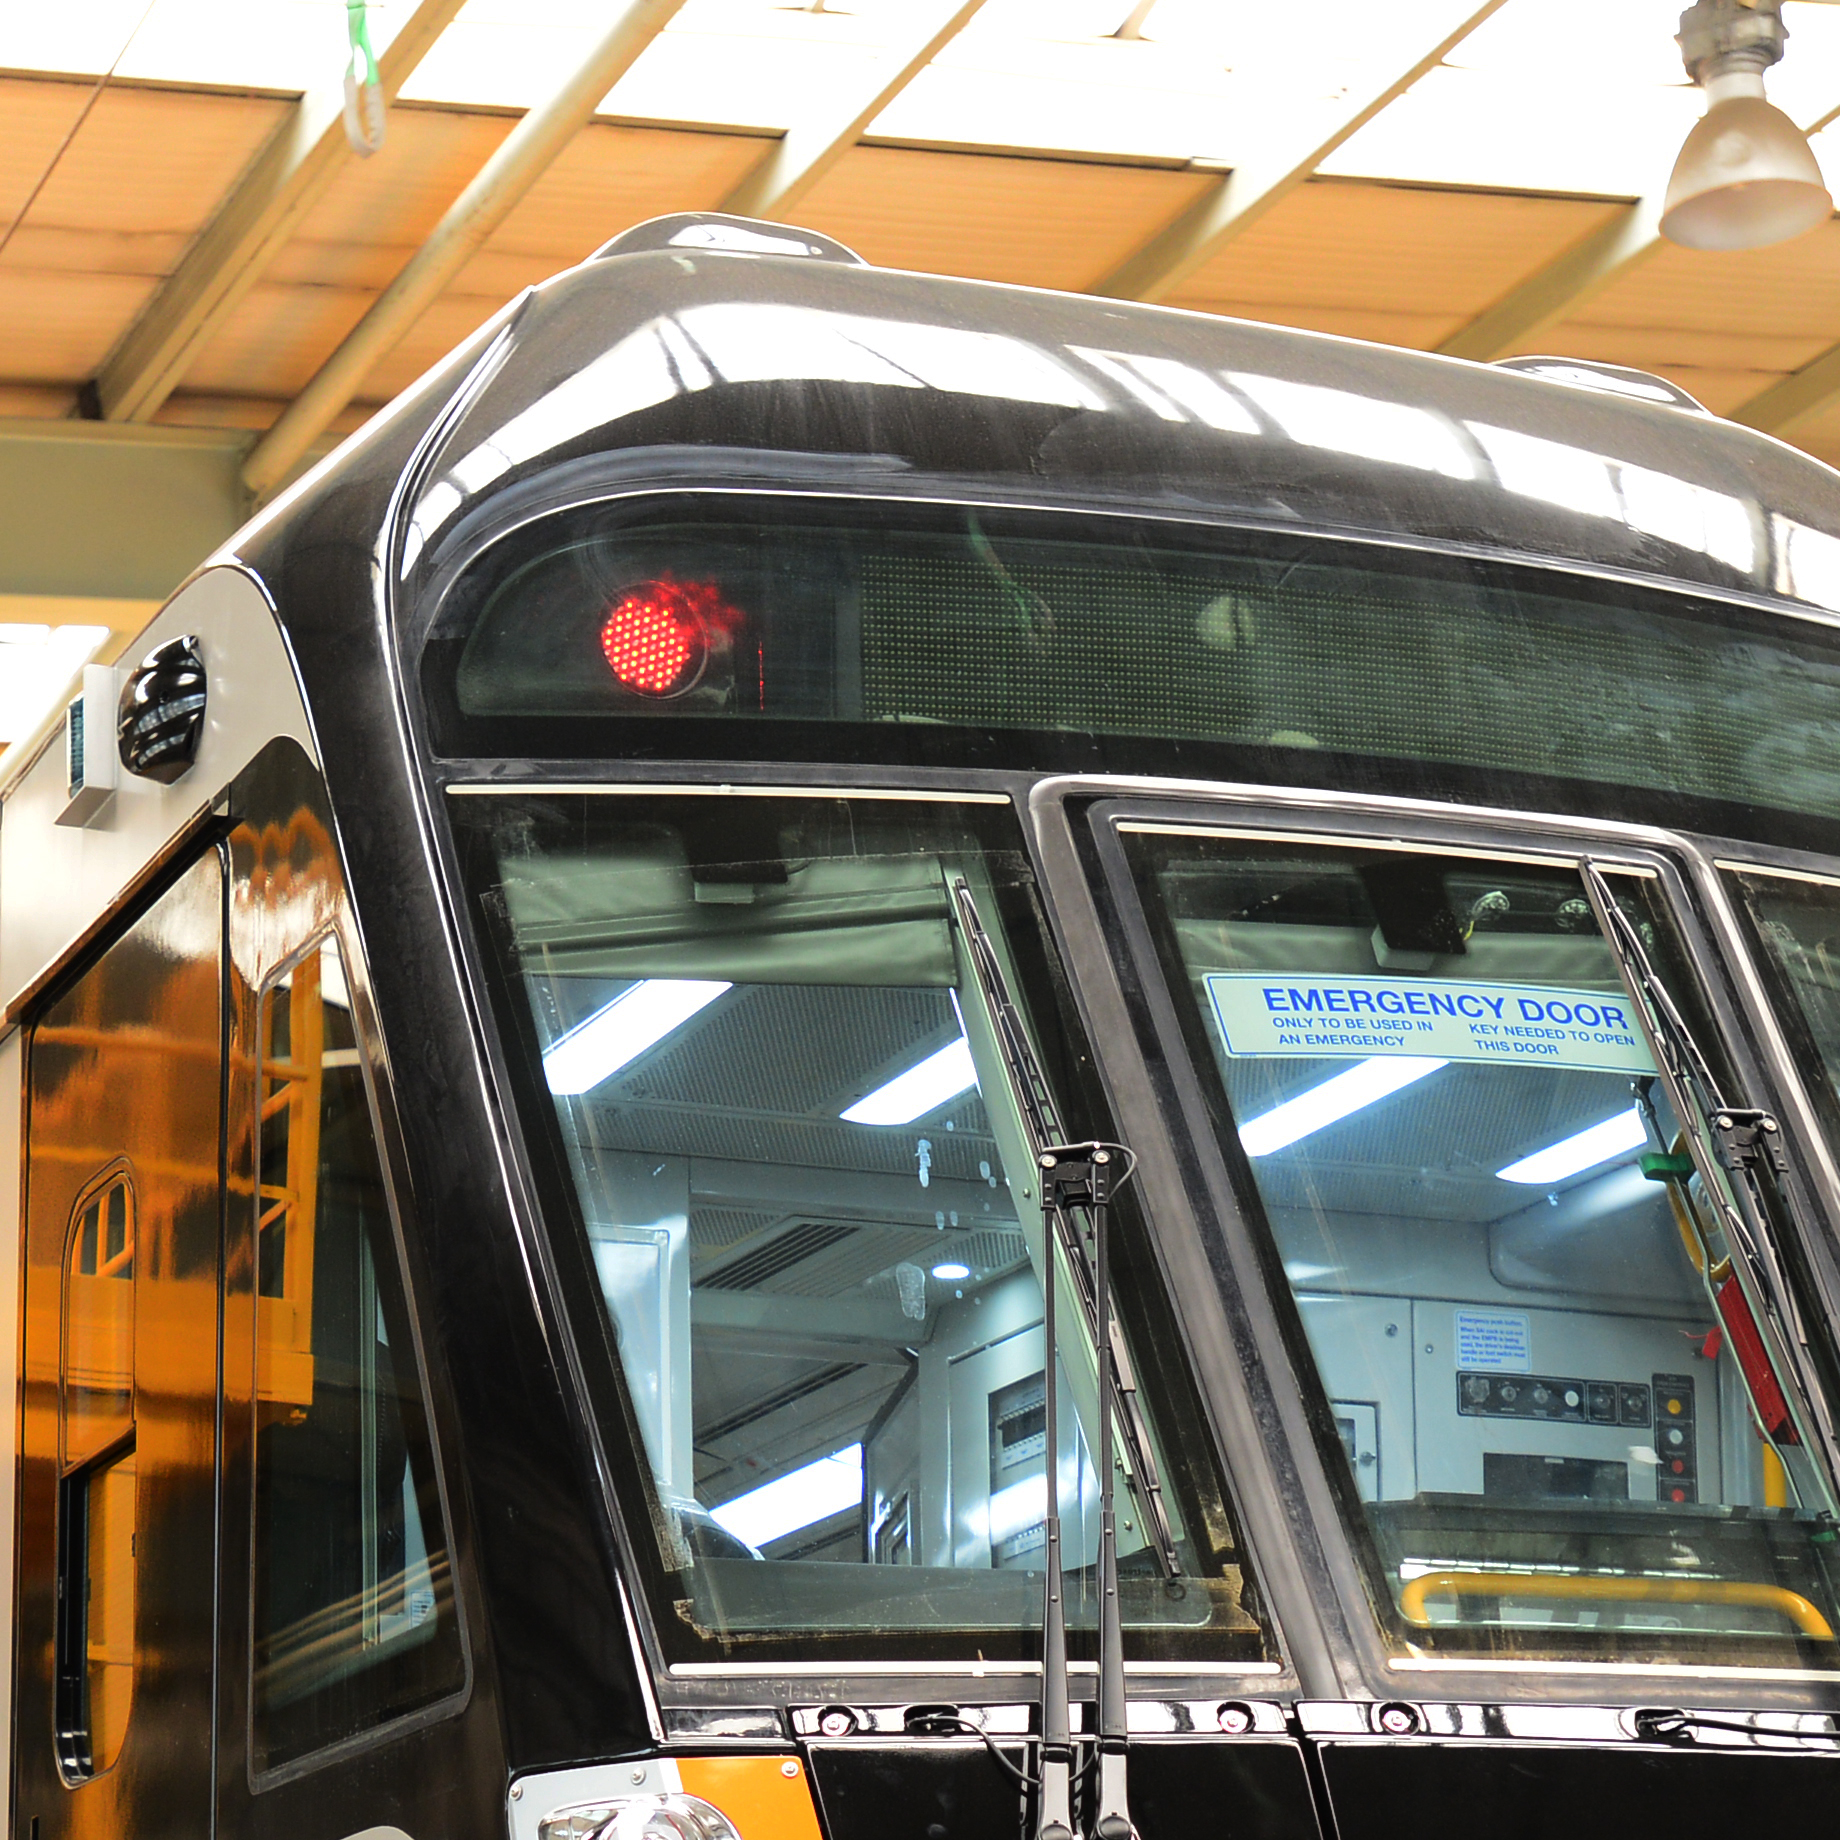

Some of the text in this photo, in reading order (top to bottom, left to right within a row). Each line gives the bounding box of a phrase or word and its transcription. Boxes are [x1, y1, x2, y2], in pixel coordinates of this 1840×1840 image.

[1262, 988, 1629, 1030] EMERGENCY DOOR
[1273, 1017, 1433, 1031] ONLY TO BE USED IN
[1279, 1034, 1405, 1046] AN EMERGENCY
[1469, 1023, 1636, 1046] KEY NEEDED TO OPEN
[1474, 1040, 1559, 1055] THIS DOOR
